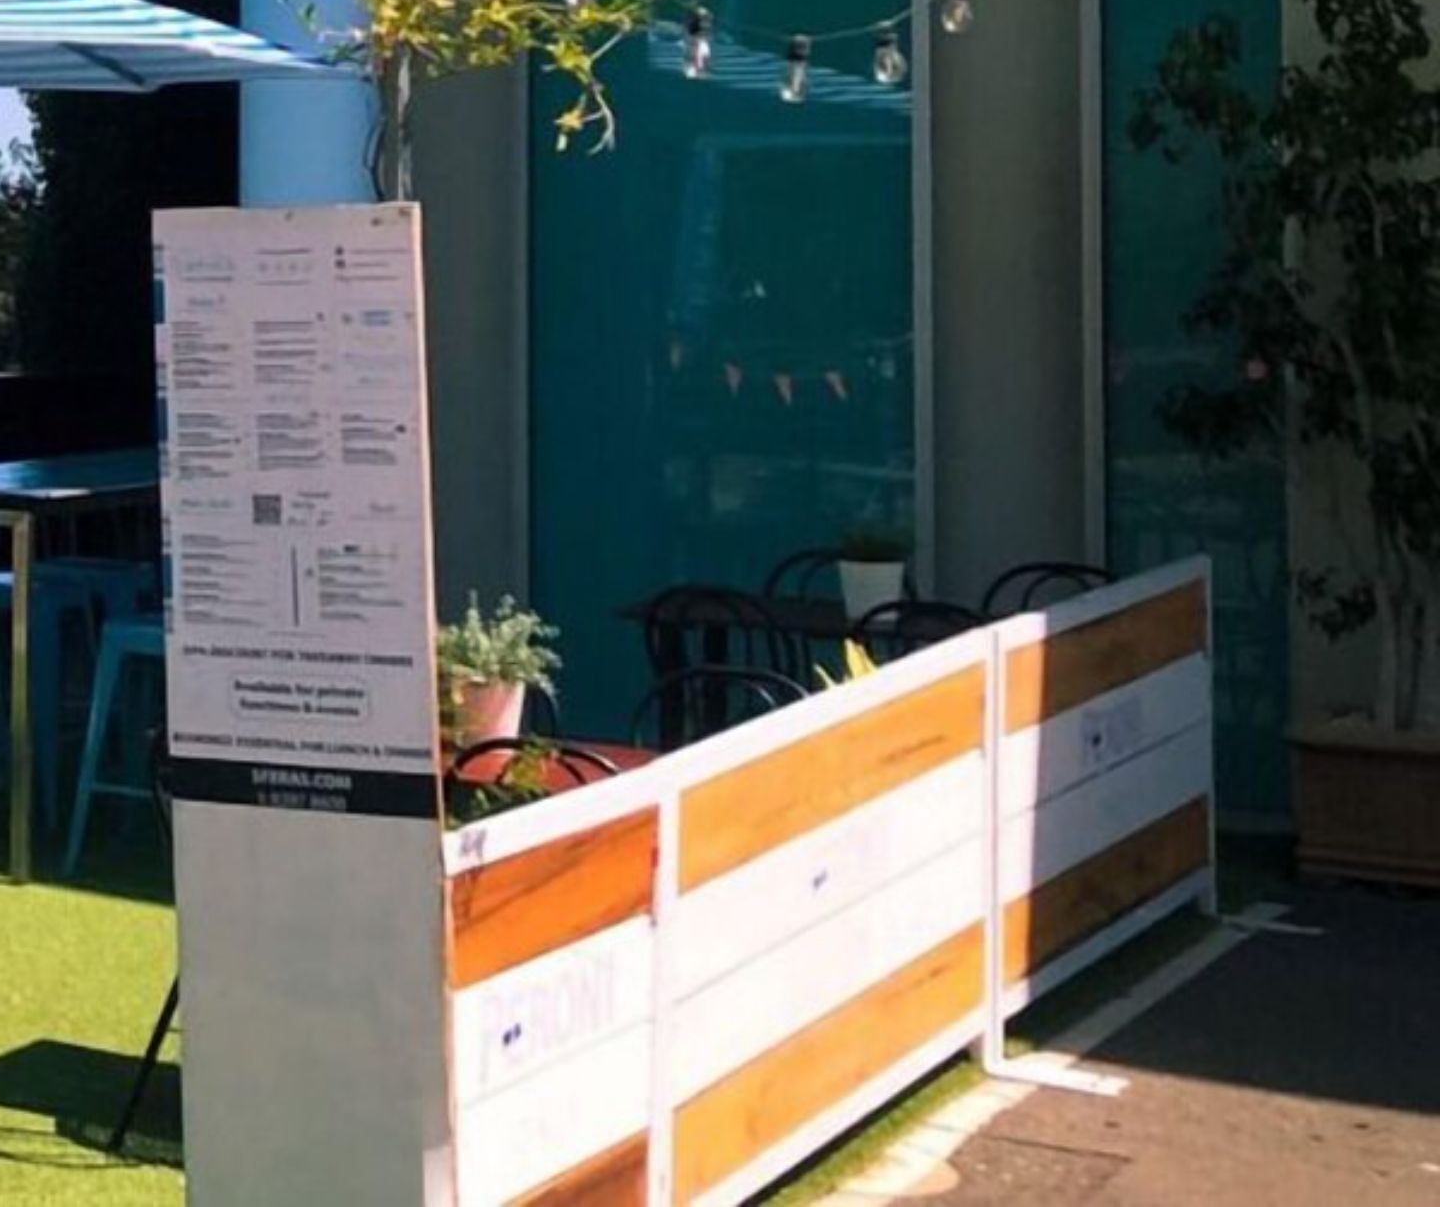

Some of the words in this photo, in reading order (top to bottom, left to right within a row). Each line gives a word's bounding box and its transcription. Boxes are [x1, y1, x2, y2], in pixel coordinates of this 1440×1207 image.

[234, 679, 292, 694] Available
[295, 683, 314, 695] for
[317, 686, 364, 699] private
